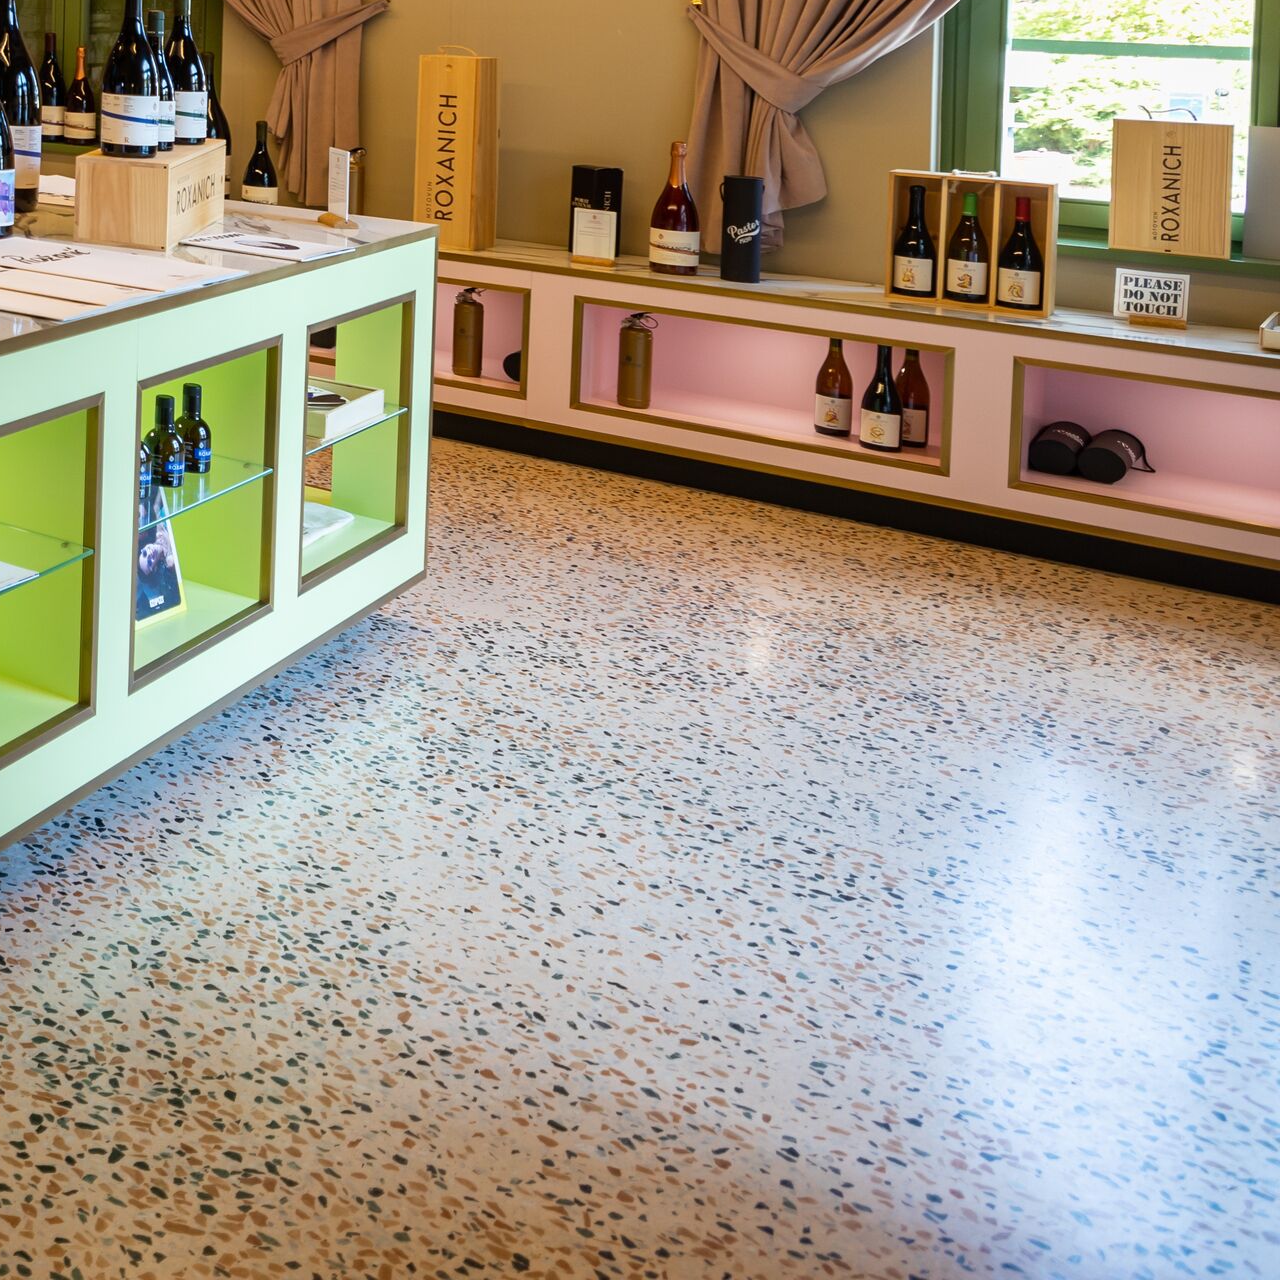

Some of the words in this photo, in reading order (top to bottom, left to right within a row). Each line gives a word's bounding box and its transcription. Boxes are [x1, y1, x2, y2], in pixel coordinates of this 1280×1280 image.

[434, 94, 458, 221] ROXANICH
[176, 173, 216, 217] ROXANICH
[1160, 145, 1182, 242] ROXANICH
[1123, 276, 1183, 292] PLEASE
[1123, 288, 1144, 301] DO
[1149, 291, 1181, 304] NOT
[1123, 301, 1178, 317] TOUCH
